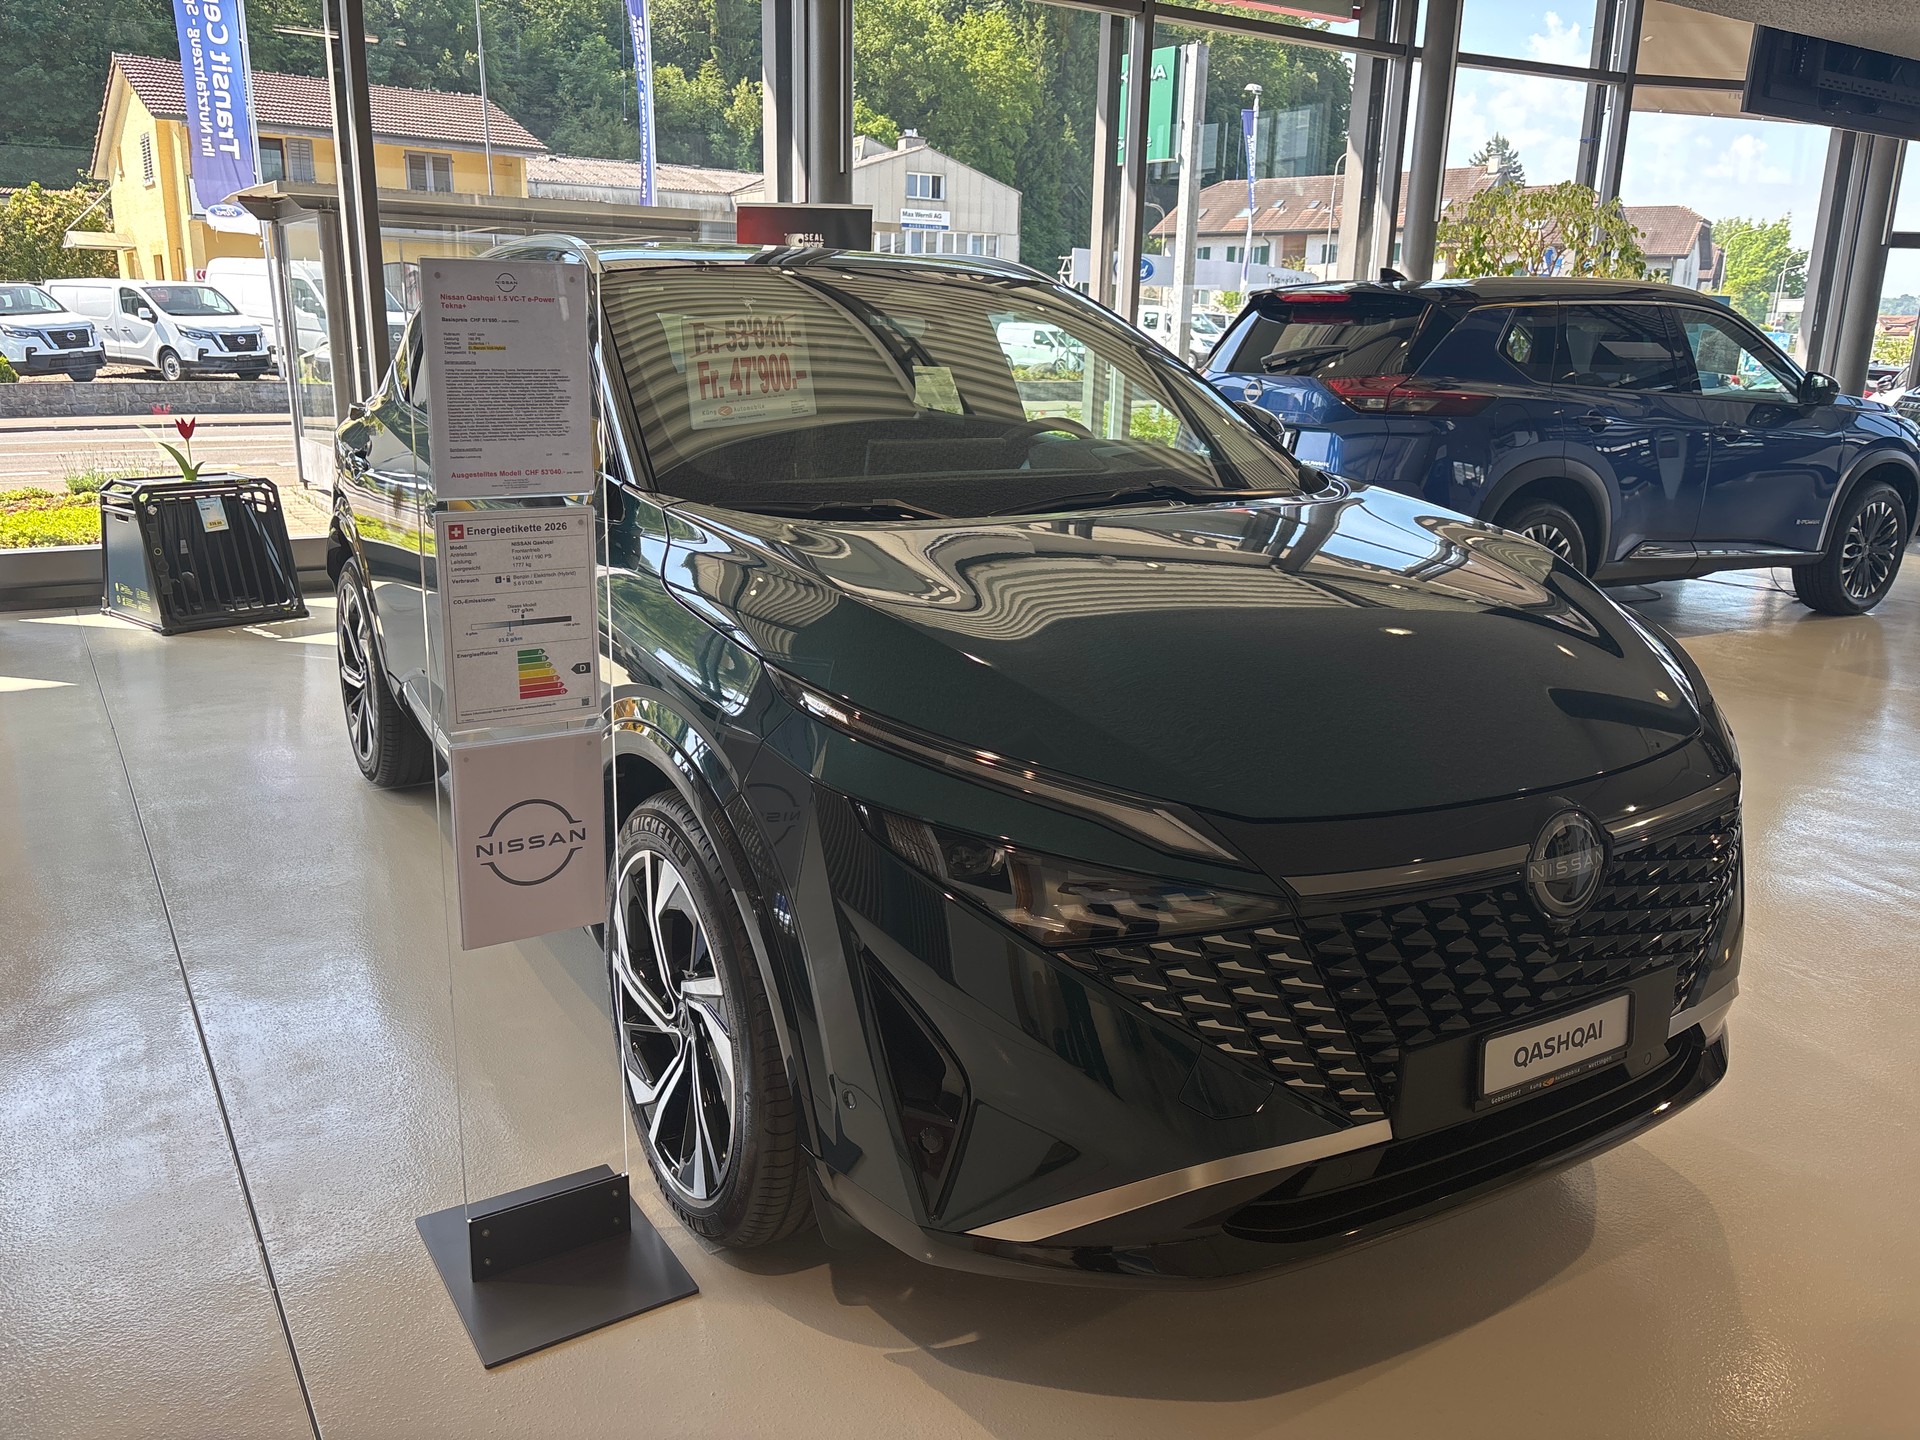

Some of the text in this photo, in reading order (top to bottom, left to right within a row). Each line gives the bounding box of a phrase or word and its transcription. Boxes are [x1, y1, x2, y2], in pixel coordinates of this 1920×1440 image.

[804, 233, 824, 241] SEAL
[440, 293, 465, 301] Nissan
[466, 294, 496, 302] Qashqai
[693, 322, 720, 354] Fr.
[697, 352, 808, 400] Fr. 47'900.-
[450, 470, 498, 480] Ausgestelltes
[499, 469, 522, 477] Modell
[466, 521, 568, 536] Energieetikette 2026
[450, 565, 481, 573] Leergewicht
[456, 650, 498, 659] Energieeffizienz
[475, 827, 586, 858] NISSAN
[631, 816, 688, 861] MICHELIN
[1530, 850, 1604, 879] NISSAN
[1513, 1019, 1604, 1068] QASHQAI
